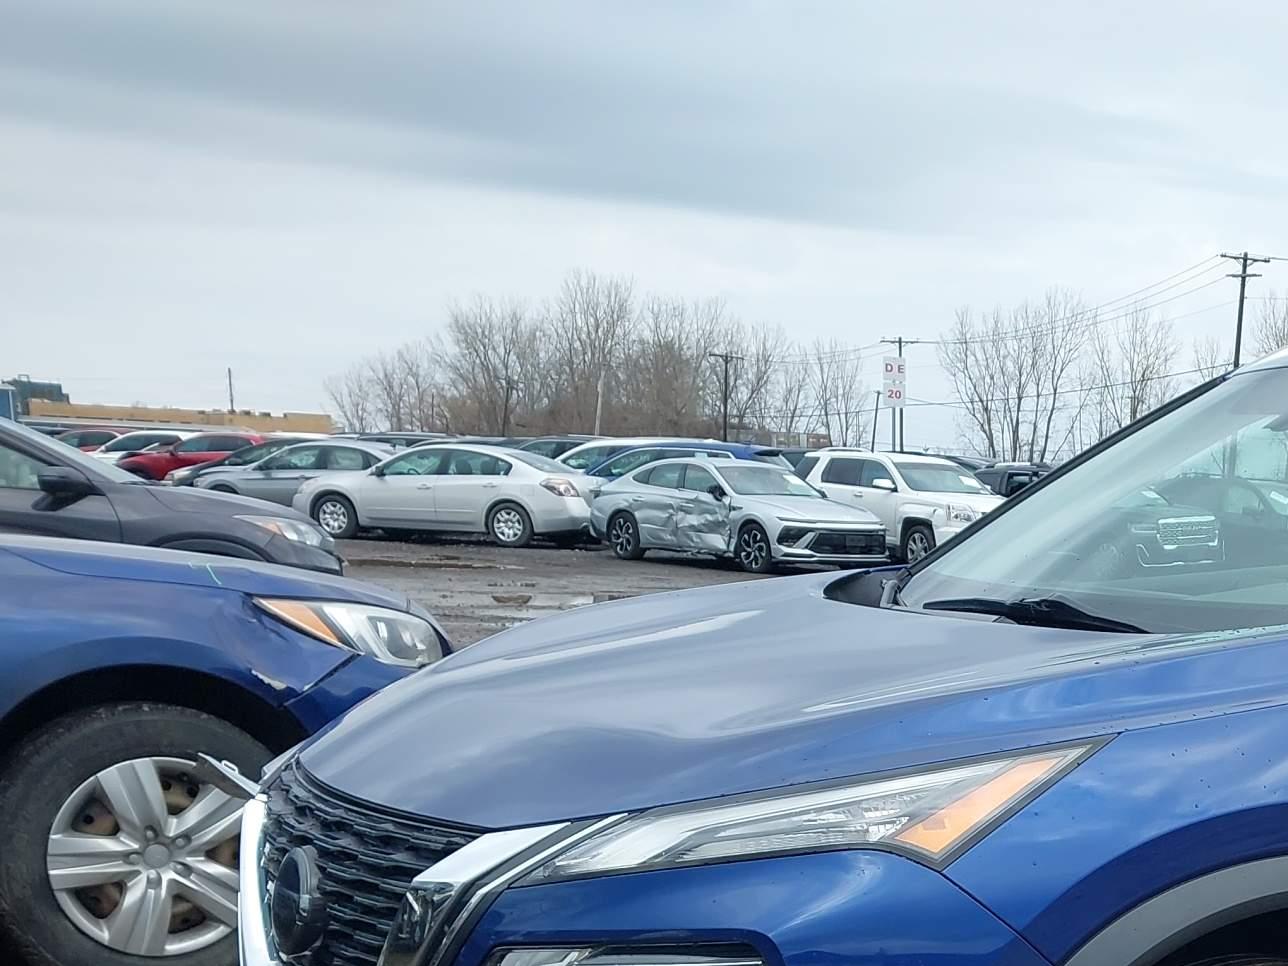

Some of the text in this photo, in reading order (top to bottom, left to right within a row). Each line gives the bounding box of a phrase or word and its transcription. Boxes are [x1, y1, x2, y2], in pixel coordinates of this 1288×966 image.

[885, 363, 904, 374] D E
[888, 389, 902, 399] 20
